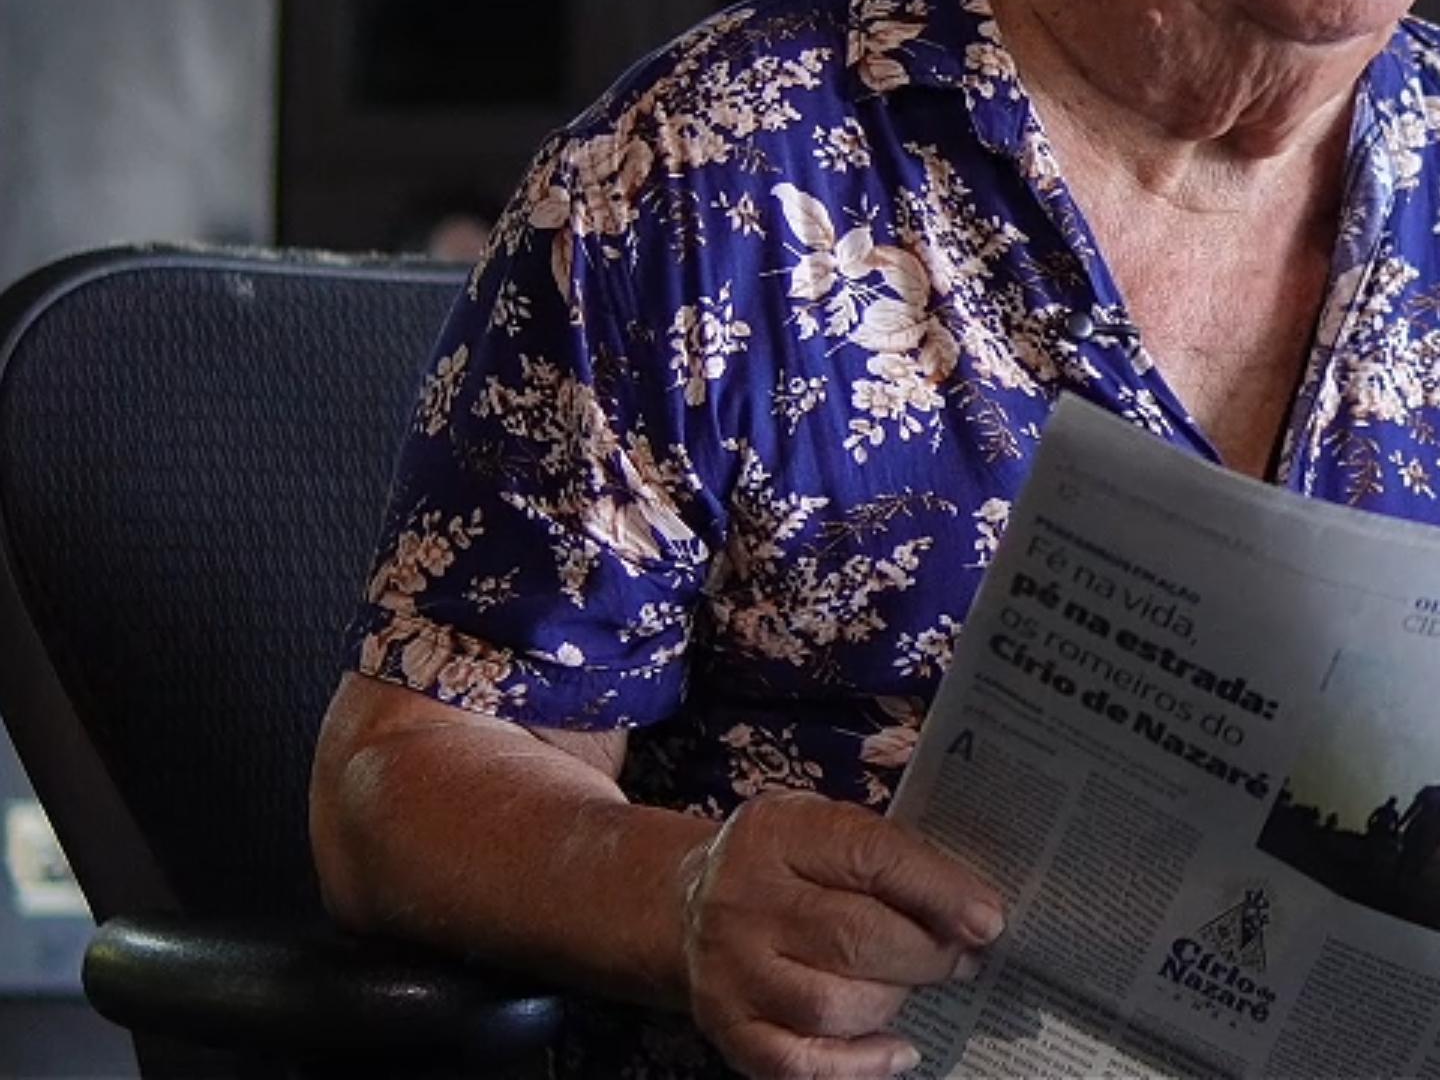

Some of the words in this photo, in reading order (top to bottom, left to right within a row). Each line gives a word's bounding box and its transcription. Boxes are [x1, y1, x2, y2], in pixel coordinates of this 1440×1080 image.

[1010, 572, 1060, 610] pé
[1063, 600, 1111, 639] na
[1115, 628, 1279, 721] estrada:
[1027, 535, 1068, 572] Fé
[1073, 565, 1117, 600] na
[1123, 588, 1199, 647] vida,
[989, 634, 1077, 697] Círio
[1081, 688, 1129, 725] de
[1132, 711, 1270, 800] Nazaré
[999, 606, 1039, 640] os
[1043, 631, 1193, 723] romeiros
[1199, 712, 1245, 748] do
[1156, 954, 1270, 1024] Nazaré
[1171, 937, 1256, 994] Círio
